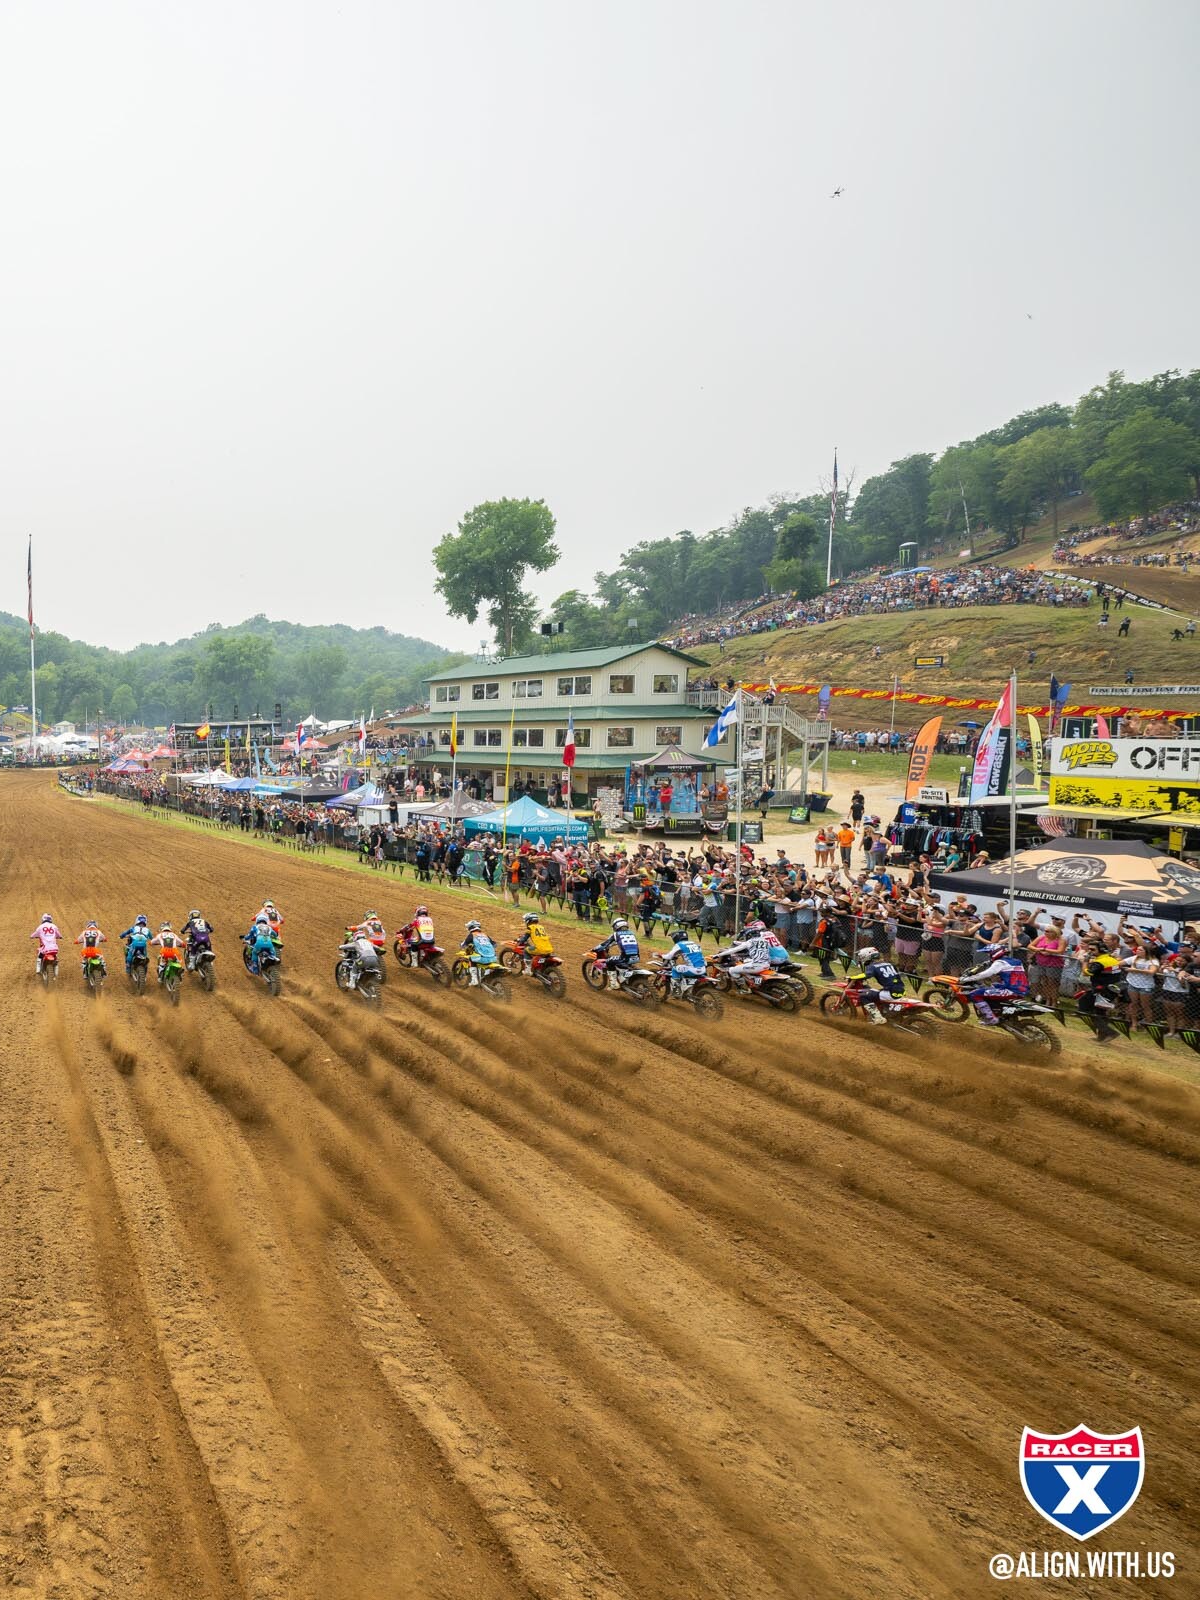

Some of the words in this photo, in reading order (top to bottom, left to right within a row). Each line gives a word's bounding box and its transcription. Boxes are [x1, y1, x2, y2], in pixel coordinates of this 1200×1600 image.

[1061, 741, 1112, 760] MOTO
[909, 745, 928, 781] RIDE
[988, 736, 1008, 795] Kawasaki
[1067, 752, 1118, 770] TEES
[42, 926, 55, 936] 96
